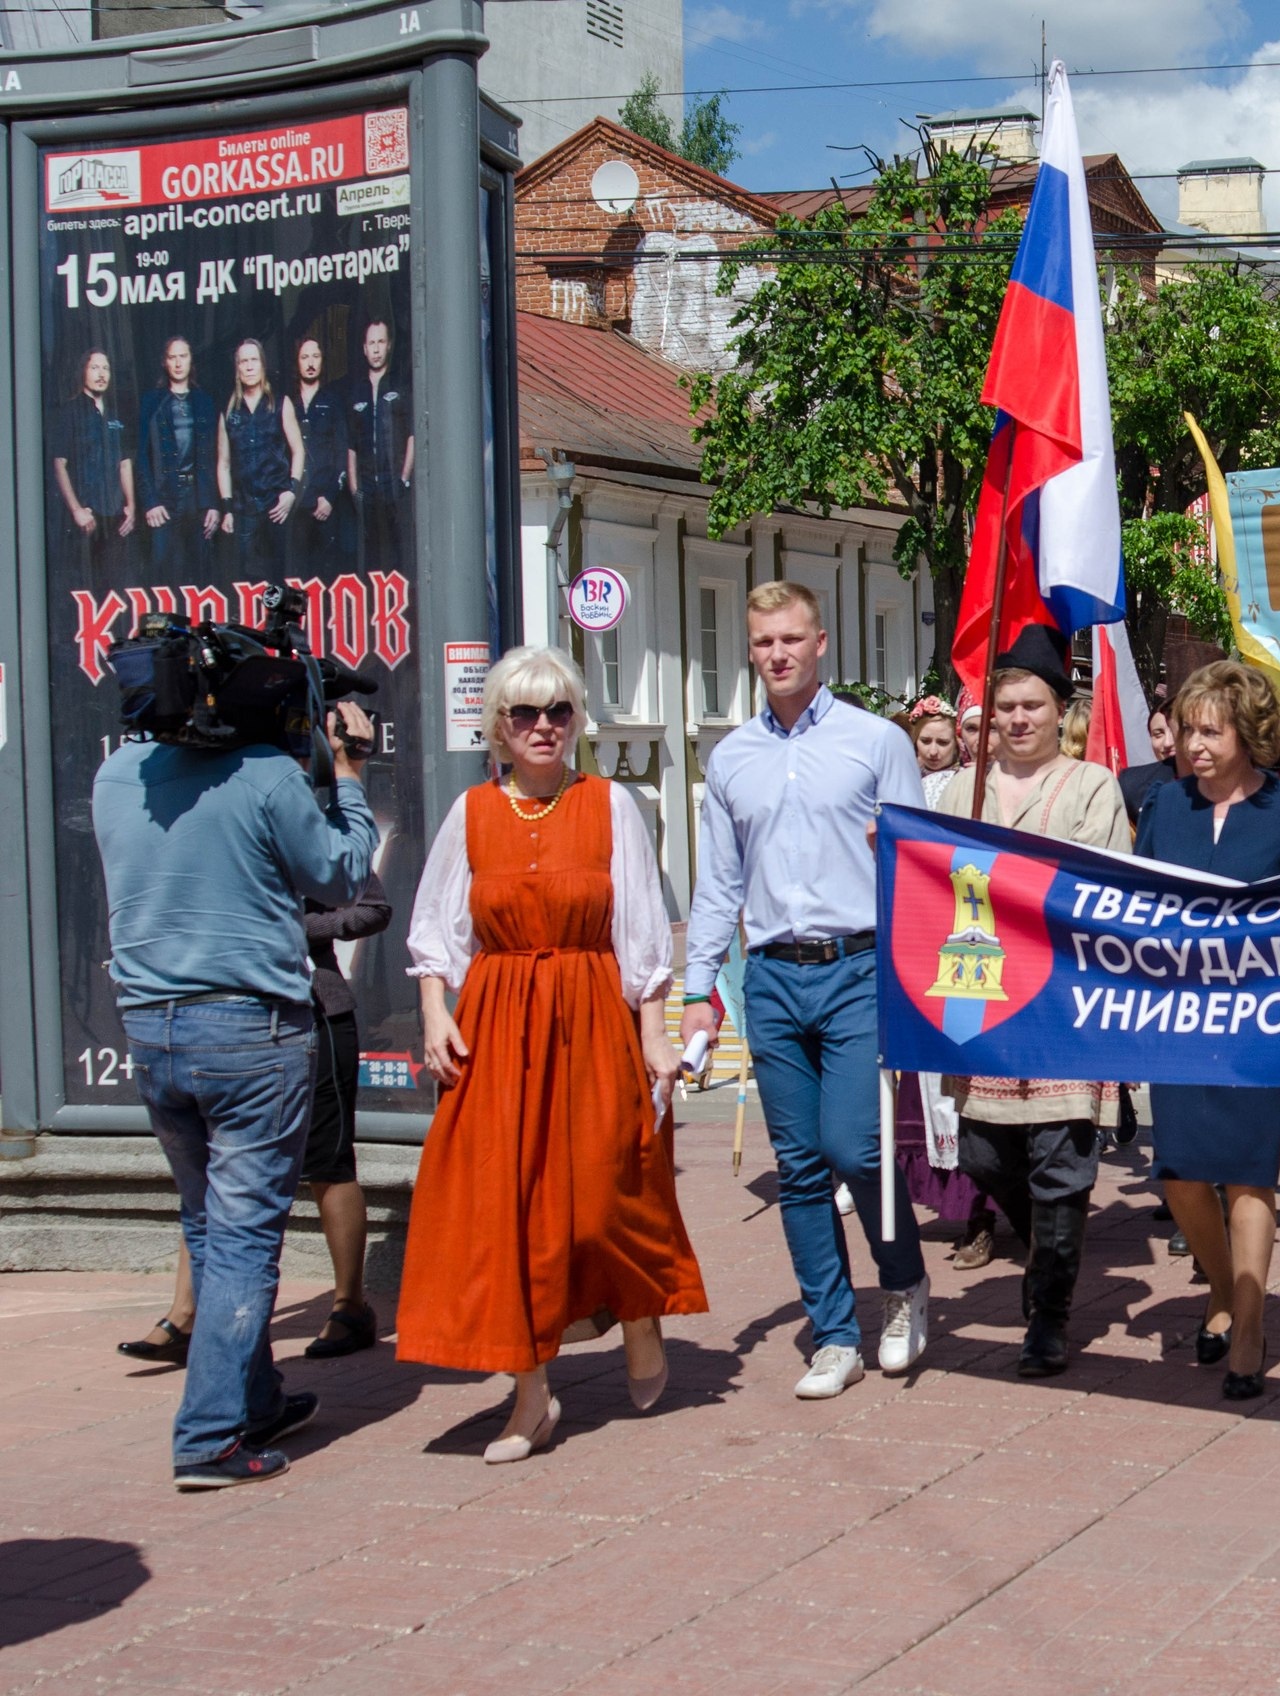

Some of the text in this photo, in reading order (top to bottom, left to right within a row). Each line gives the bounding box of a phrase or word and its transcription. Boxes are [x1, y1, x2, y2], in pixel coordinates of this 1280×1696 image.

[400, 10, 421, 34] 1A
[0, 70, 22, 92] A
[218, 130, 311, 157] Билеты online
[161, 143, 345, 199] GORKASSA.RU
[338, 184, 391, 202] Апрель
[47, 220, 87, 232] билеты
[124, 191, 321, 240] april-concert.ru
[362, 214, 412, 232] г. Тверь
[136, 250, 169, 268] 19-00
[56, 252, 118, 308] 15
[196, 258, 238, 305] ДК
[582, 579, 612, 603] BR
[448, 647, 490, 661] ВНИМА
[463, 666, 489, 674] ОБЪЕК
[453, 707, 484, 715] НАБЛЮД
[78, 1047, 134, 1086] 12+
